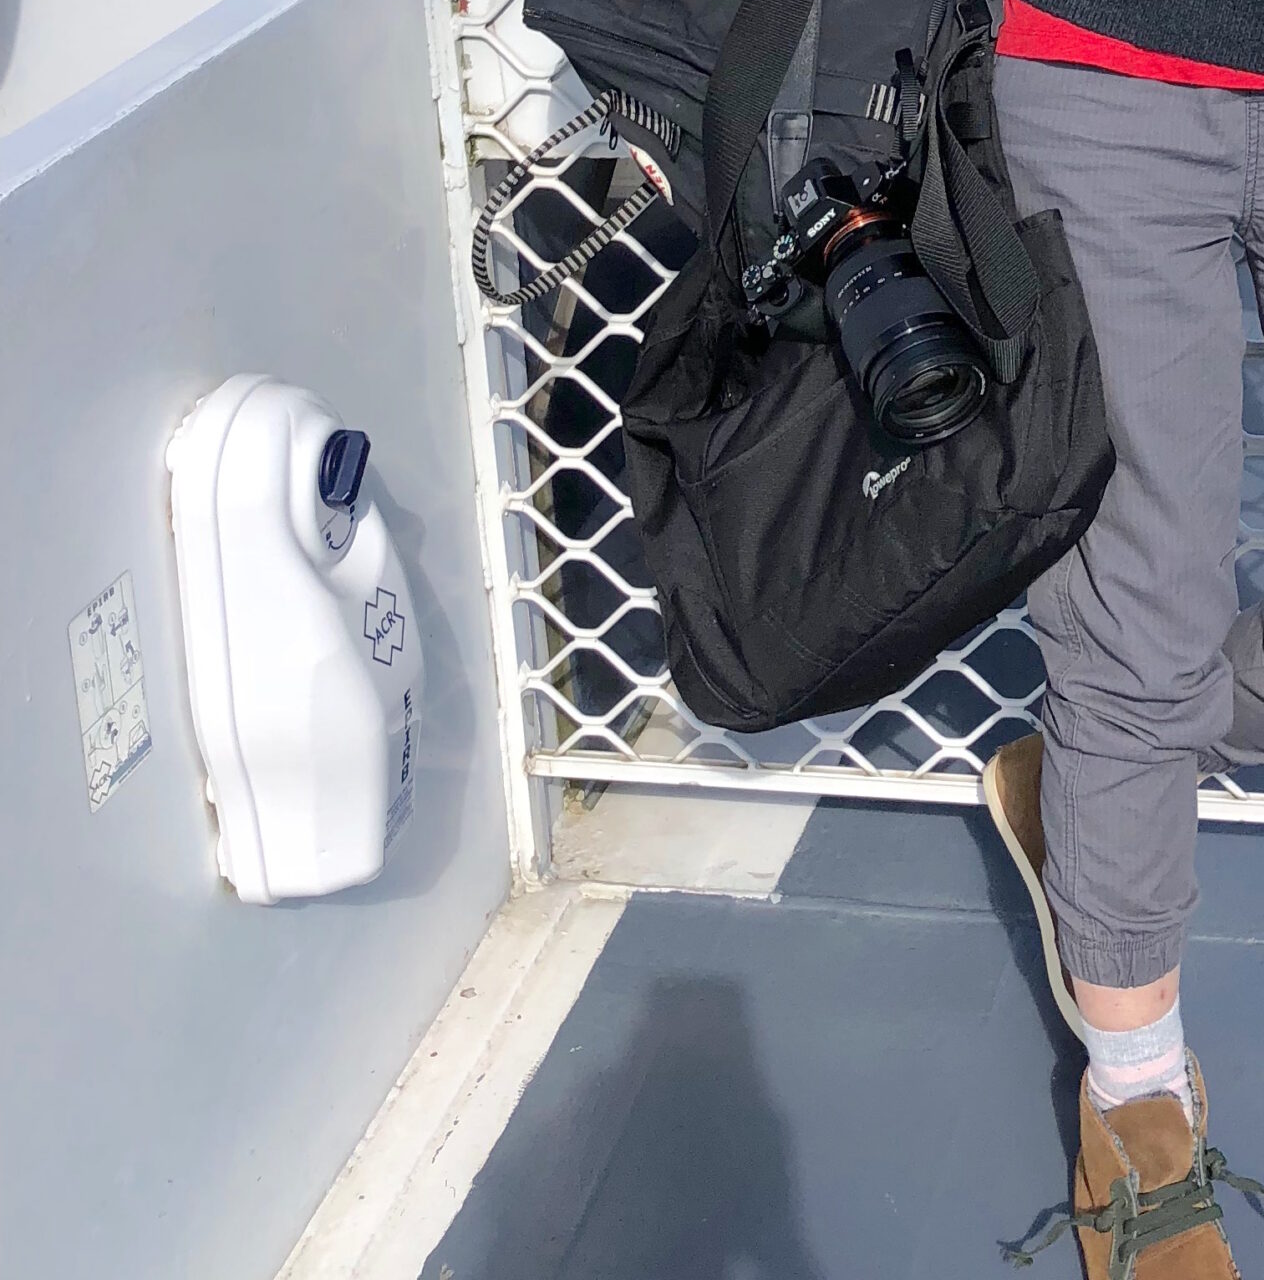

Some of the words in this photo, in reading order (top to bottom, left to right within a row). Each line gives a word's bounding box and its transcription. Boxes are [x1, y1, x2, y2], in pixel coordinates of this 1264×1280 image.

[806, 207, 837, 239] SONY
[86, 586, 116, 618] EPIRB
[374, 610, 396, 646] ACR
